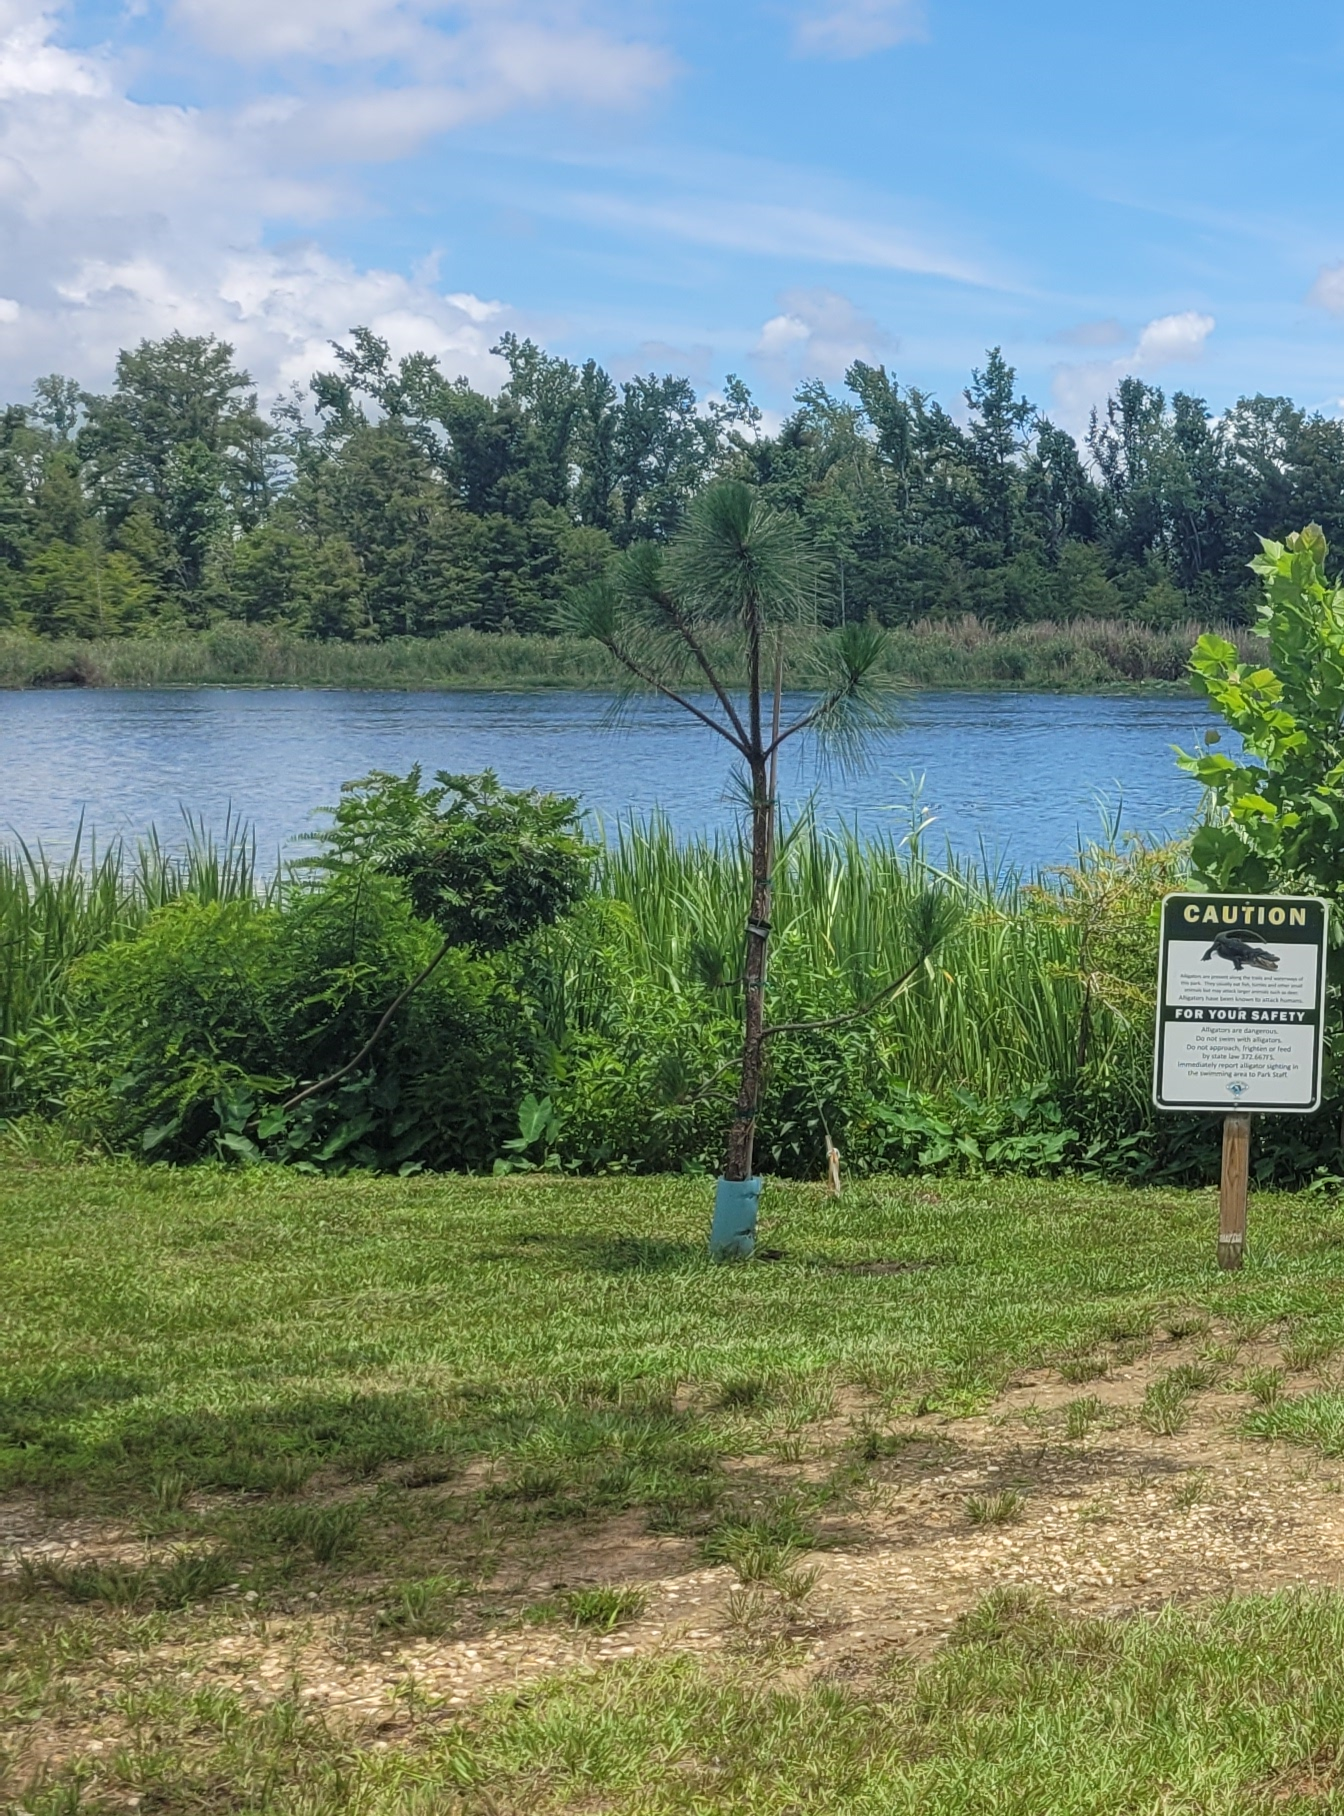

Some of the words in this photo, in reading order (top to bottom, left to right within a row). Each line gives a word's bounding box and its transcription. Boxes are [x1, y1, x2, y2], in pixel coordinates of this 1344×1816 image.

[1184, 904, 1306, 926] CAUTION
[1175, 1009, 1203, 1019] FOR
[1208, 1010, 1246, 1020] YOUR
[1251, 1011, 1305, 1021] SAFETY
